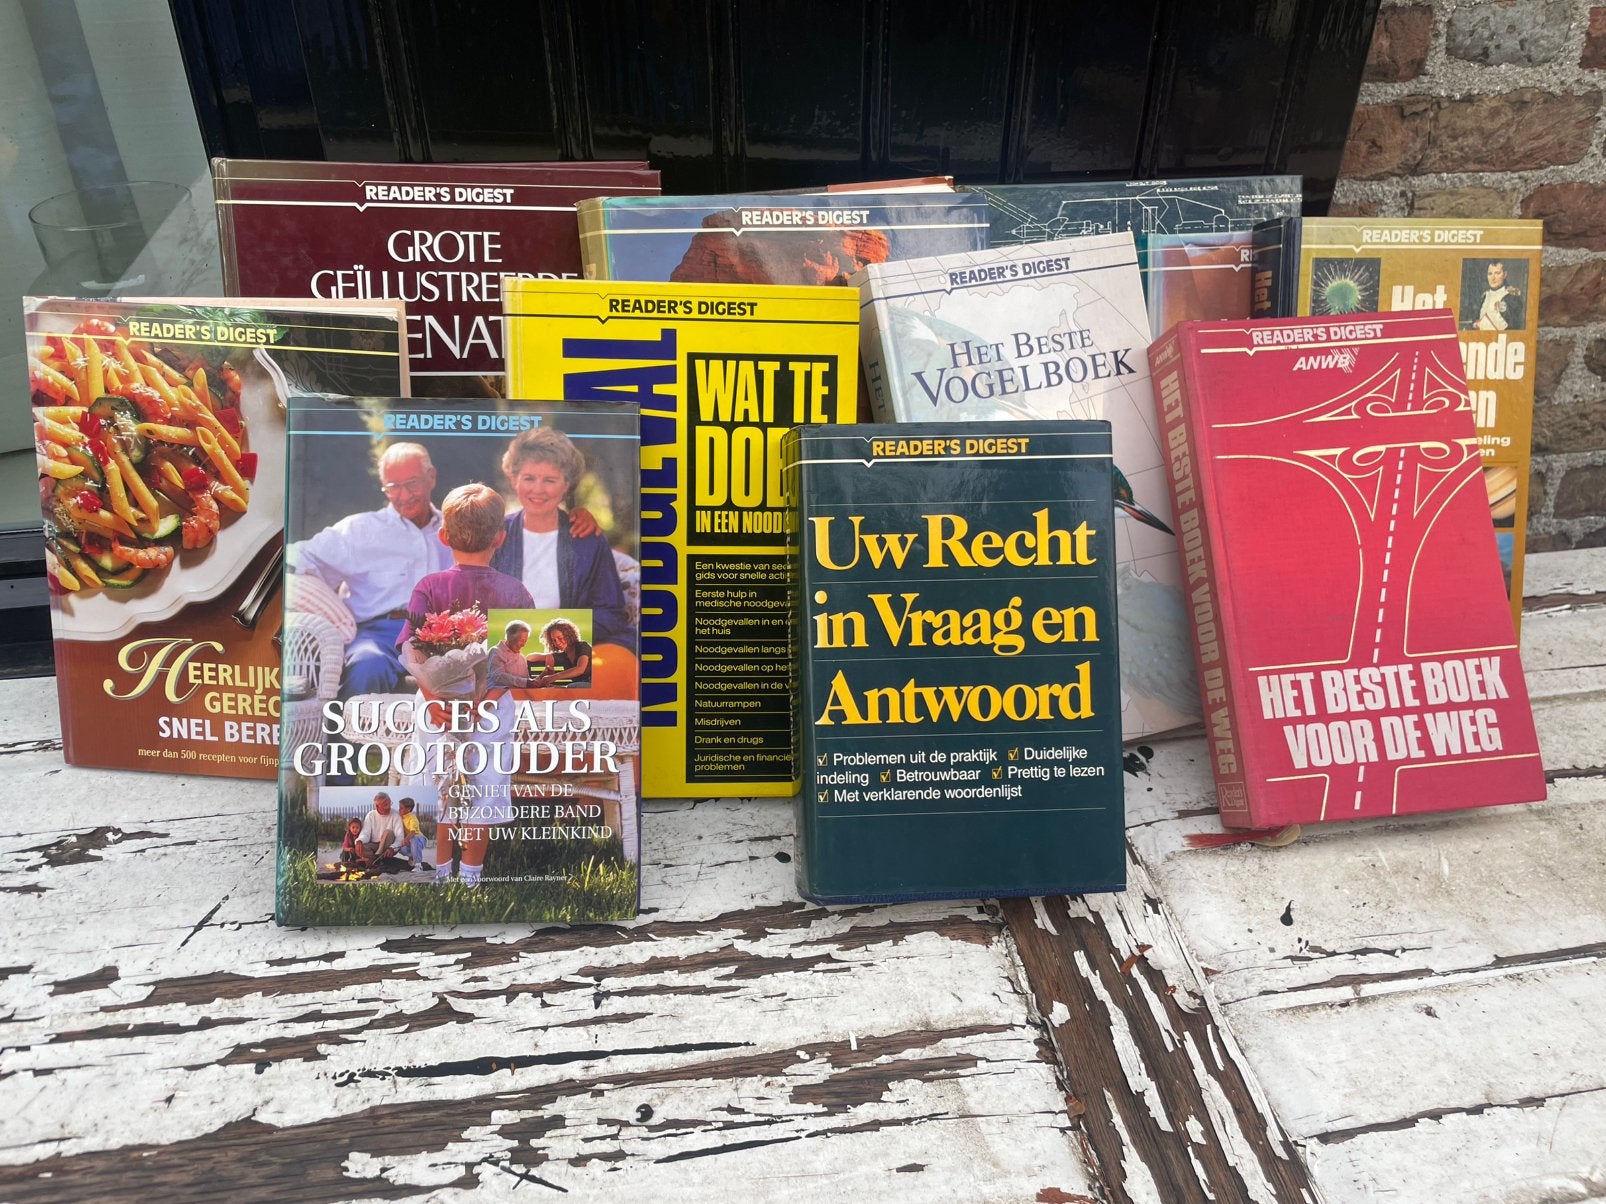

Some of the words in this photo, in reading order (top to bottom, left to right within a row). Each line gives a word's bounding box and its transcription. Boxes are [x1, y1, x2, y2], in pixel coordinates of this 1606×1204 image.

[365, 185, 451, 201] READER'S
[454, 187, 514, 203] DIGEST
[741, 210, 815, 225] READER'S
[818, 210, 869, 224] DIGEST
[1362, 229, 1431, 243] READER'S
[1434, 230, 1484, 243] DIGEST
[387, 230, 502, 263] GROTE
[949, 264, 1018, 286] READER'S
[1022, 257, 1070, 275] DIGEST
[311, 265, 577, 302] GEÏLLUSTRE
[1255, 270, 1273, 311] Het
[609, 298, 693, 315] READER'S
[697, 300, 758, 316] DIGEST
[128, 321, 212, 340] READER'S
[216, 327, 277, 343] DIGEST
[1252, 327, 1327, 345] READER'S
[1329, 324, 1384, 340] DIGEST
[1292, 354, 1350, 371] ANWB
[695, 359, 780, 423] WAT
[788, 361, 829, 424] TE
[1160, 370, 1184, 424] HET
[383, 414, 472, 430] READER'S
[477, 415, 543, 431] DIGEST
[872, 440, 961, 456] READER'S
[965, 438, 1029, 454] DIGEST
[695, 425, 790, 508] DOE
[1167, 422, 1196, 508] BESTE
[696, 511, 711, 533] IN
[714, 511, 739, 533] EEN
[809, 516, 918, 570] Uw
[921, 508, 1097, 568] Recht
[1180, 508, 1207, 584] BOEK
[695, 562, 714, 570] Een
[715, 562, 752, 570] kwestie
[695, 571, 716, 580] gids
[739, 572, 767, 580] snelle
[695, 589, 725, 598] Eerste
[726, 590, 748, 599] hulp
[748, 590, 757, 598] in
[695, 600, 742, 608] medische
[695, 617, 760, 627] Noodgevallen
[761, 618, 770, 626] in
[695, 627, 711, 635] het
[711, 627, 731, 635] huis
[813, 590, 869, 648] in
[867, 593, 1025, 656] Vraag
[1031, 606, 1100, 644] en
[1191, 583, 1220, 664] VOOR
[695, 645, 760, 655] Noodgevallen
[761, 645, 786, 655] langs
[695, 663, 760, 673] Noodgevallen
[761, 665, 774, 673] op
[695, 682, 760, 692] Noodgevallen
[761, 682, 769, 690] in
[770, 682, 783, 690] de
[815, 660, 1095, 726] Antwoord
[1204, 667, 1226, 704] DE
[1257, 672, 1316, 719] HET
[1321, 664, 1420, 714] BESTE
[1421, 656, 1509, 705] BOEK
[695, 700, 761, 709] Natuurrampen
[322, 699, 501, 735] SUCCES
[511, 699, 592, 733] ALS
[695, 718, 741, 727] Misdrijven
[158, 716, 218, 742] SNEL
[695, 736, 722, 744] Drank
[737, 736, 764, 745] drugs
[1210, 706, 1238, 775] WEG
[1283, 719, 1379, 769] VOOR
[1380, 715, 1425, 761] DE
[1424, 708, 1503, 756] WEG
[138, 748, 161, 757] meer
[163, 749, 179, 759] dan
[180, 749, 197, 760] 500
[199, 752, 236, 764] recepten
[238, 755, 258, 764] voor
[293, 741, 620, 777] GROOTOUDER
[694, 754, 741, 762] Juridische
[833, 751, 906, 766] Problemen
[910, 751, 925, 764] uit
[929, 751, 947, 763] de
[950, 749, 998, 765] praktijk
[1024, 747, 1088, 763] Duidelijke
[695, 763, 745, 772] problemen
[816, 771, 869, 786] indeling
[896, 767, 982, 783] Betrouwbaar
[1007, 765, 1050, 781] Prettig
[1053, 767, 1066, 778] te
[1069, 764, 1105, 778] lezen
[448, 784, 511, 798] GENIET
[514, 784, 547, 797] VAN
[551, 784, 573, 797] DE
[834, 788, 860, 803] Met
[863, 787, 941, 801] verklarende
[944, 785, 1023, 800] woordenlijst
[449, 805, 550, 819] BIJZONDERE
[555, 805, 602, 818] BAND
[447, 827, 485, 841] MET
[488, 827, 521, 841] UW
[521, 826, 612, 840] KLEINKIND
[544, 874, 567, 882] Rayner
